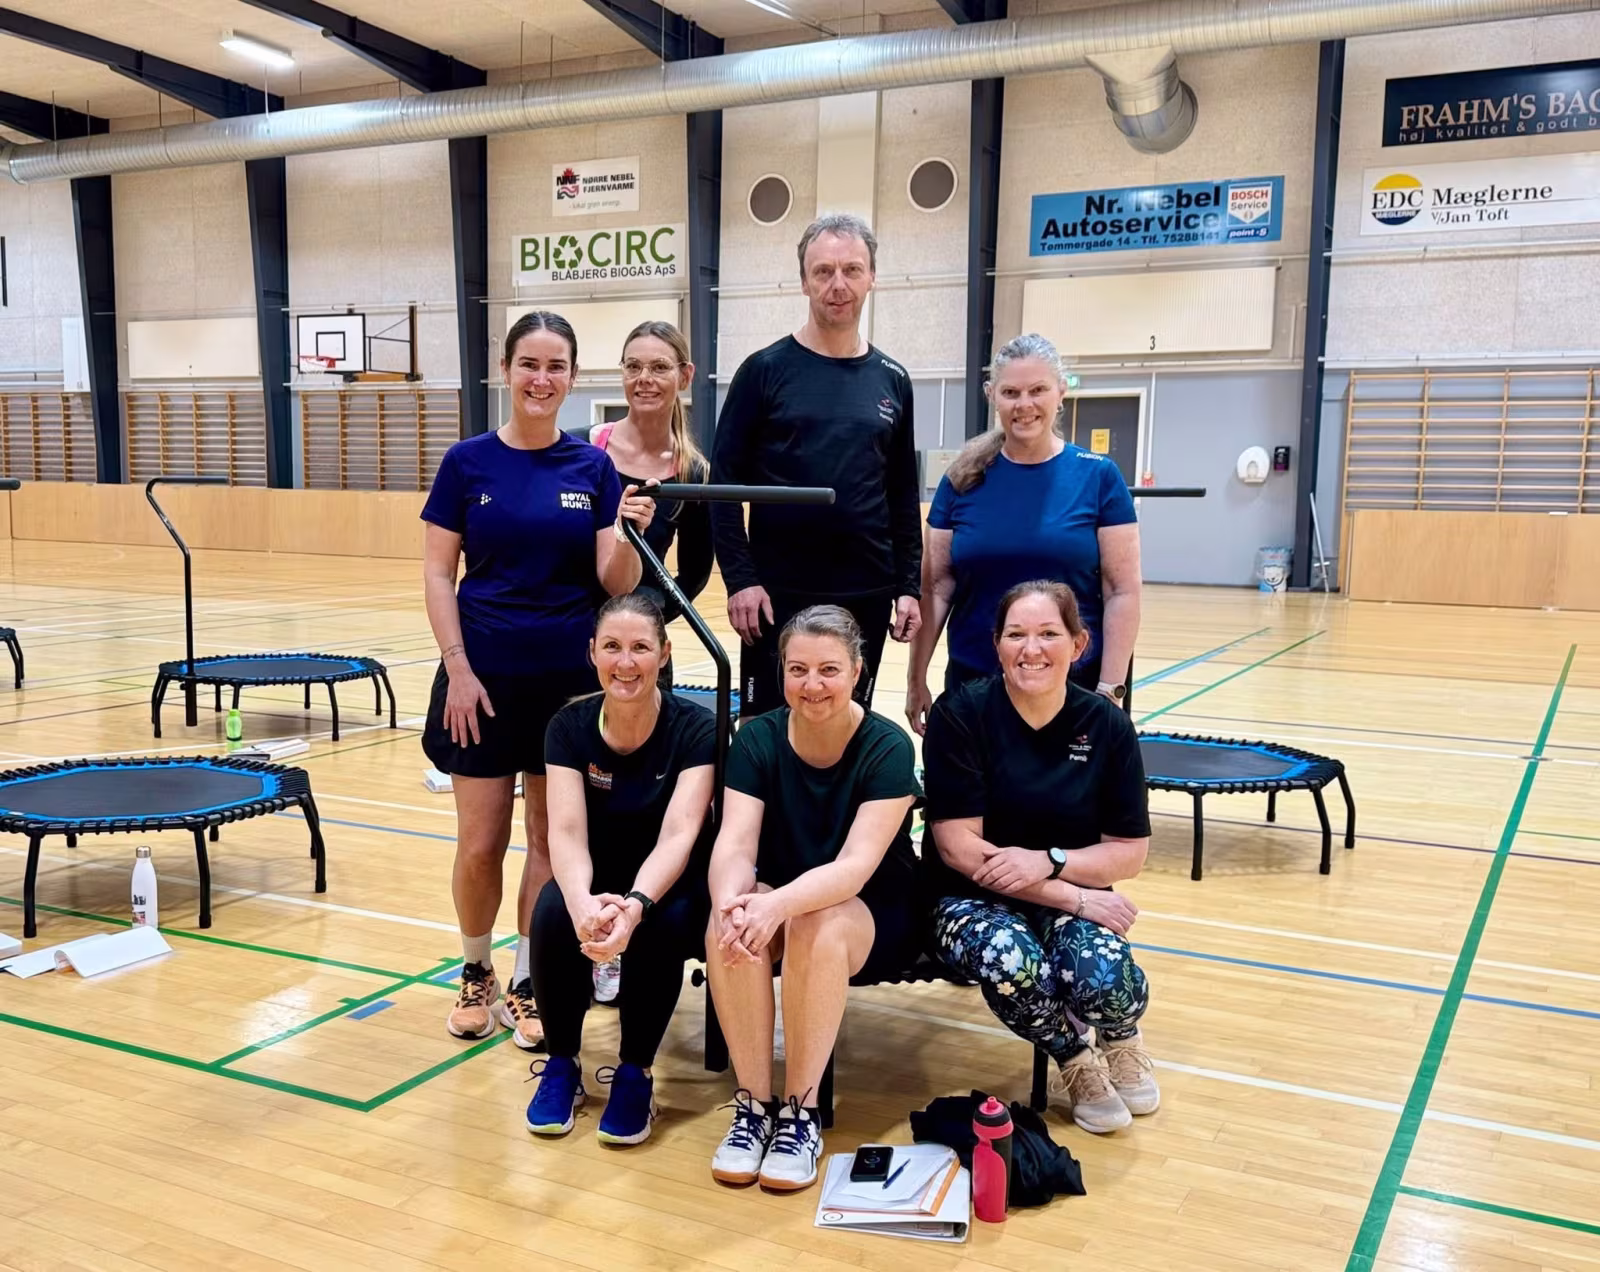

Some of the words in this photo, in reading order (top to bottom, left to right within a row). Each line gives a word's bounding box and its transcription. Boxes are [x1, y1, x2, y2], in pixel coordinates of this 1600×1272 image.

[1400, 92, 1536, 130] FRAHM'S
[1436, 123, 1506, 139] kvalitet
[1516, 121, 1526, 132] &
[1536, 117, 1577, 133] godt
[582, 175, 608, 184] NØRRE
[610, 172, 635, 182] NEBEL
[583, 182, 635, 193] FJERNVARME
[1231, 189, 1269, 201] BOSCH
[1371, 188, 1424, 210] EDC
[1432, 184, 1553, 207] Mæglerne
[1085, 194, 1123, 216] Nr.
[1230, 201, 1268, 211] Service
[1475, 208, 1510, 222] Toft
[1041, 210, 1219, 240] Autoservice
[1117, 236, 1130, 246] 14
[610, 265, 652, 278] BIOGAS
[654, 264, 676, 276] ApS
[1149, 335, 1156, 350] 3
[881, 359, 905, 377] FUSION
[1076, 452, 1104, 461] FUSION
[561, 493, 591, 502] ROYAL
